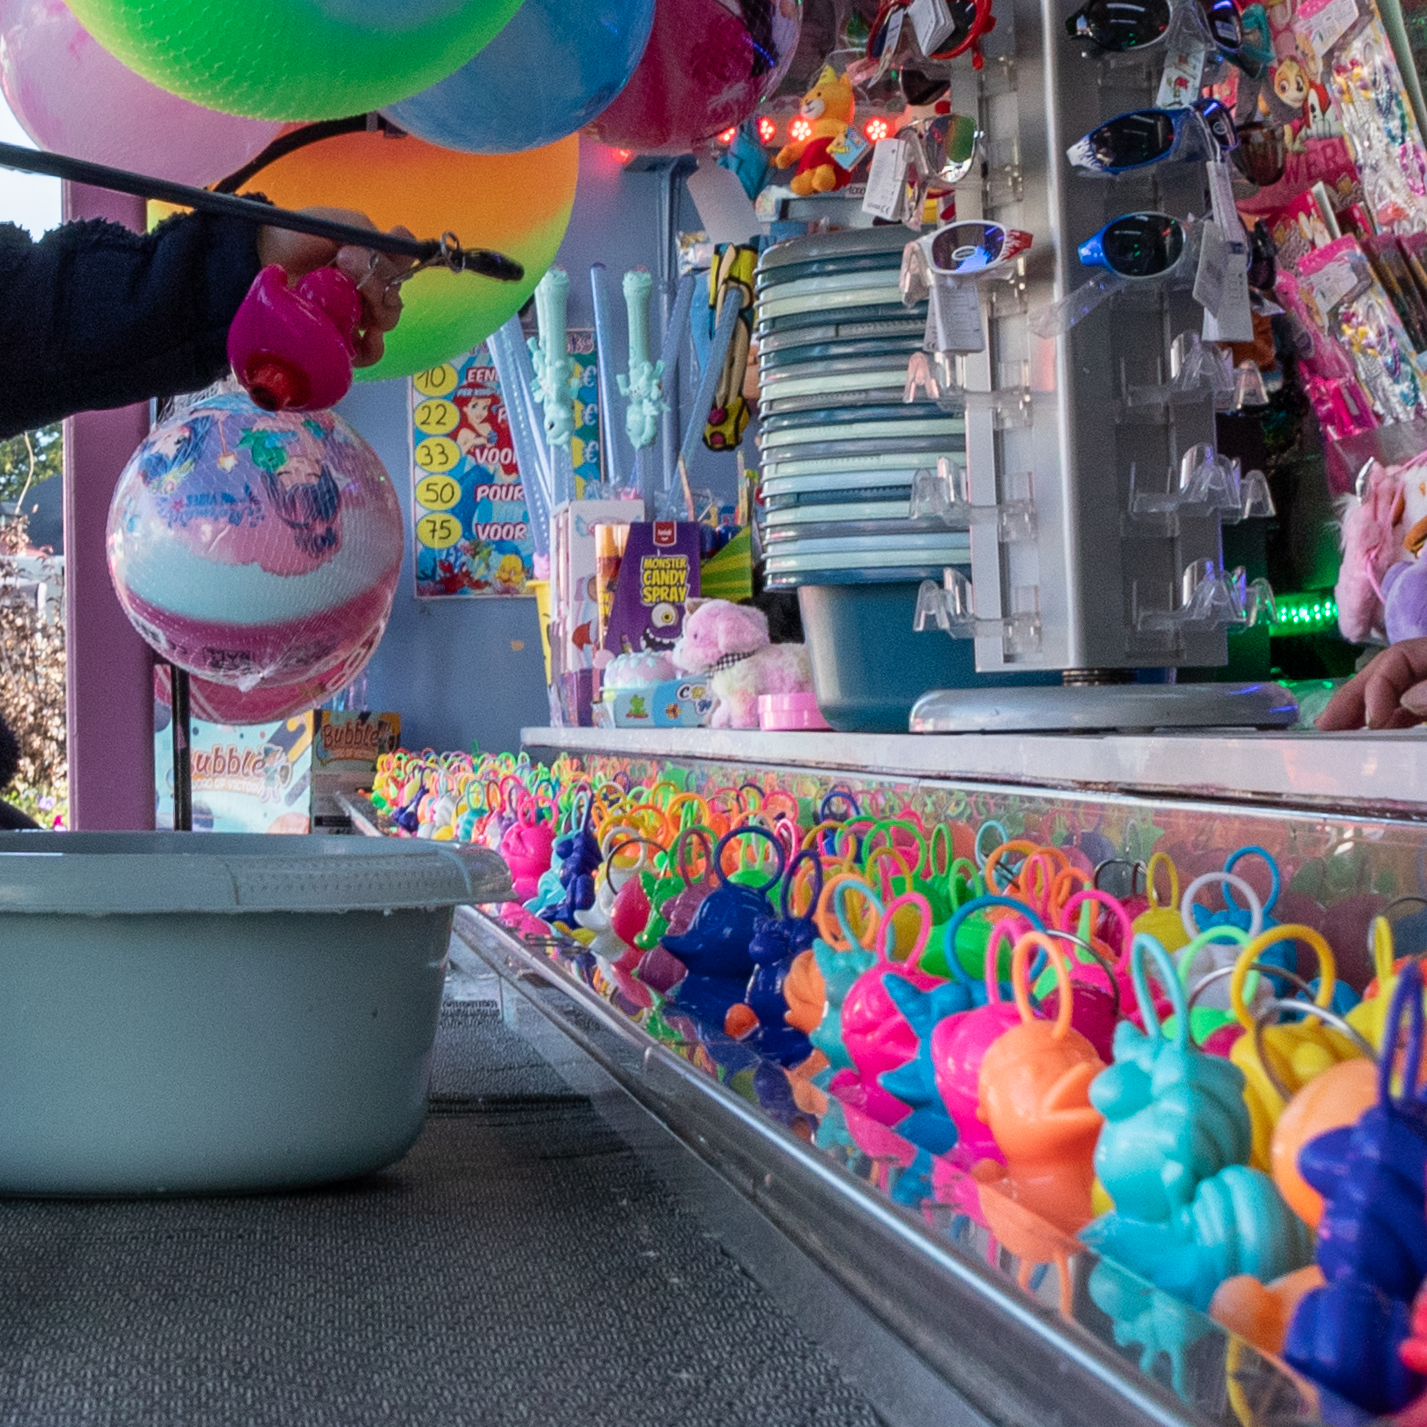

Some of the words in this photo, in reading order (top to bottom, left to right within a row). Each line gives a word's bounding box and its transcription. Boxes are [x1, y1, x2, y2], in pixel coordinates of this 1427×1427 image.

[418, 403, 449, 426] 22
[419, 442, 450, 466] 33
[424, 481, 455, 503] 50
[429, 518, 452, 540] 75
[476, 524, 527, 542] VOOR
[643, 556, 687, 570] MONSTER
[642, 569, 686, 587] CANDY
[642, 584, 687, 604] SPRAY
[323, 718, 380, 749] Bubble
[190, 743, 266, 776] ubble
